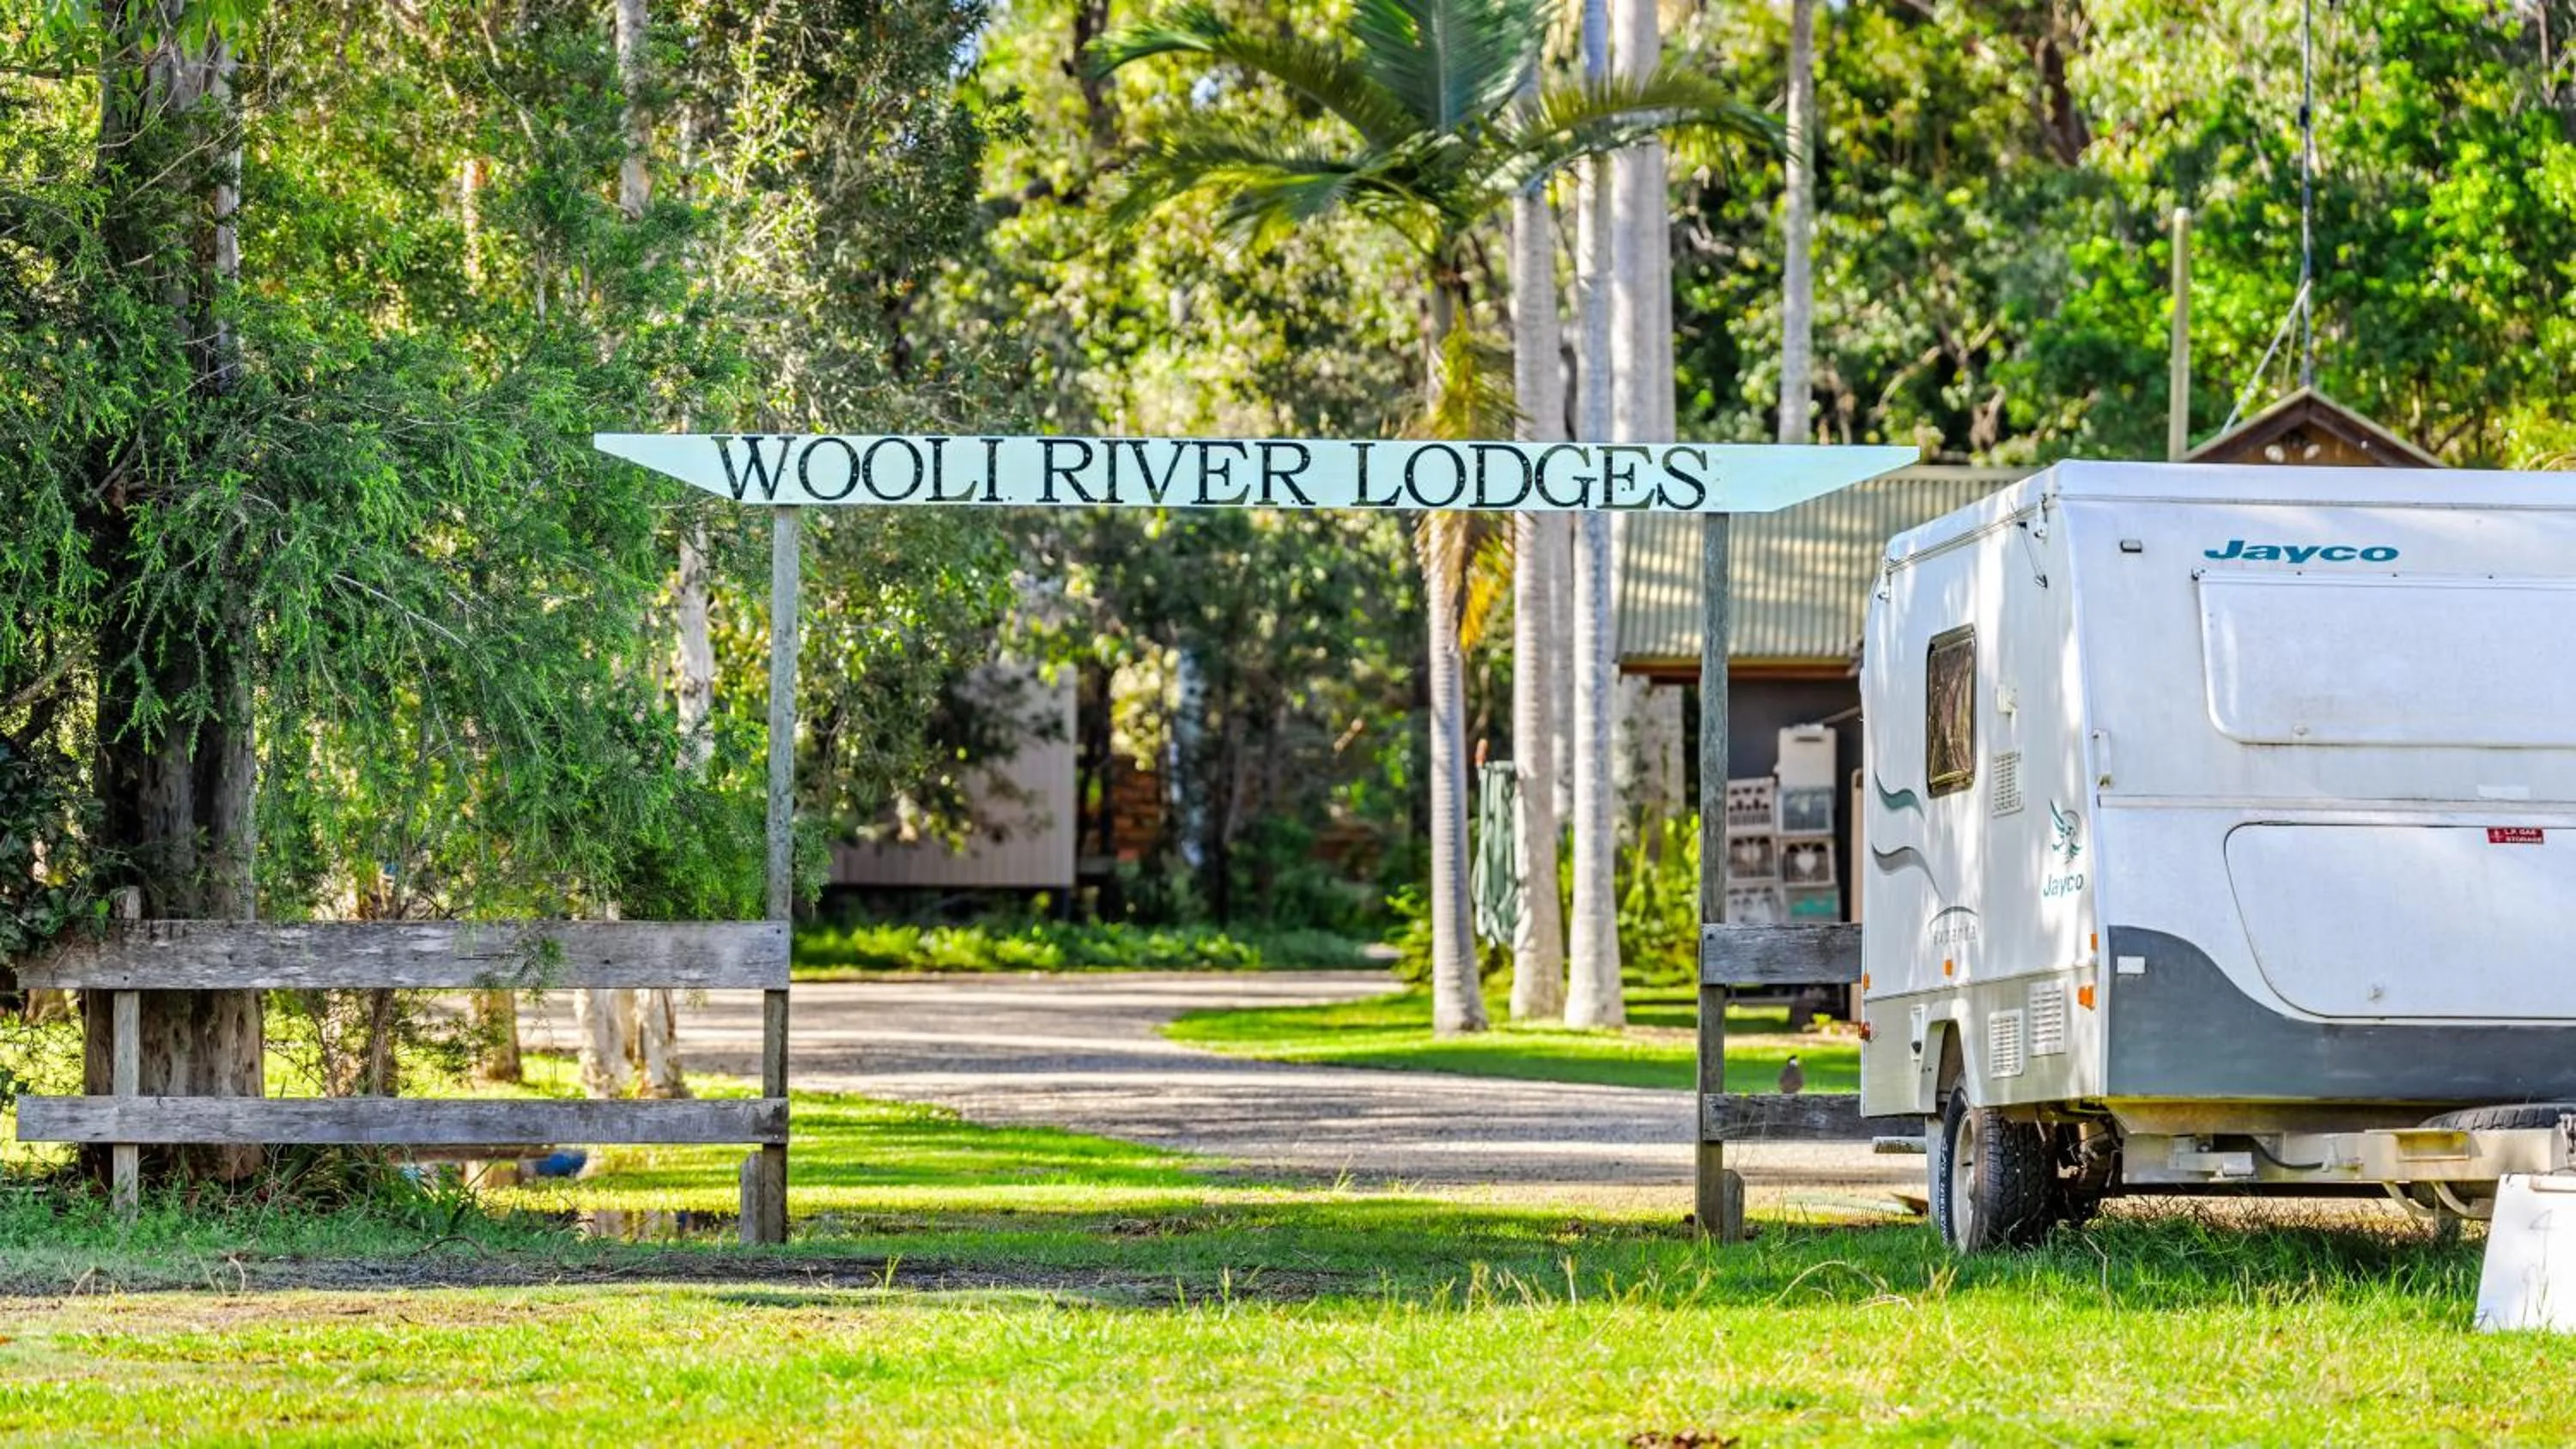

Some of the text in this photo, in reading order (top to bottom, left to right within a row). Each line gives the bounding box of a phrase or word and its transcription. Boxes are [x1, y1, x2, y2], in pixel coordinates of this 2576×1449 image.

[710, 435, 1708, 511] WOOLI RIVER LODGES
[2203, 539, 2400, 564] Jayco
[2043, 873, 2084, 898] Jayco
